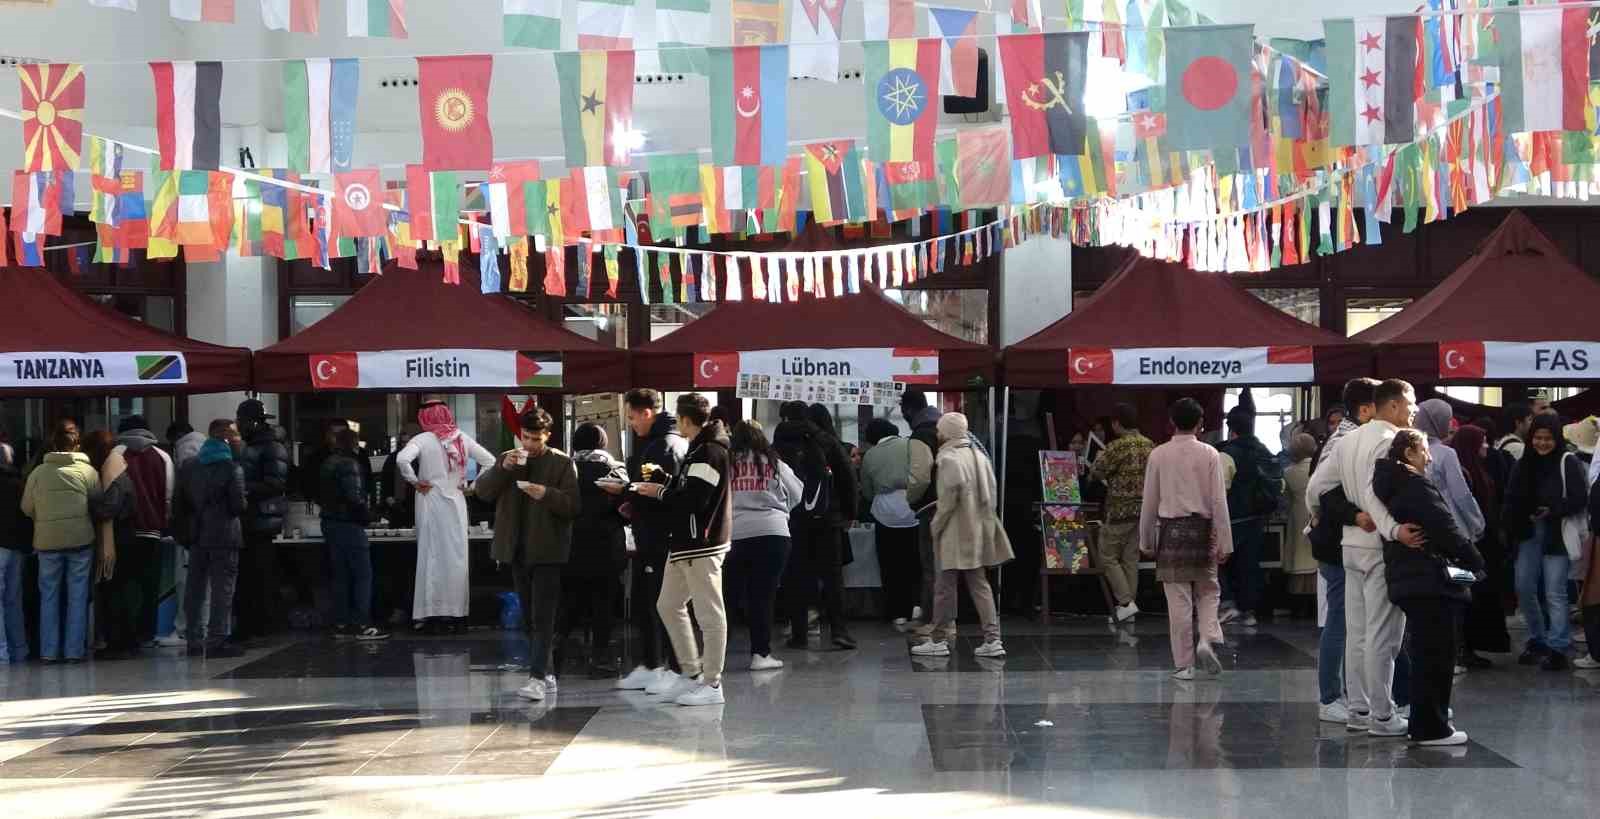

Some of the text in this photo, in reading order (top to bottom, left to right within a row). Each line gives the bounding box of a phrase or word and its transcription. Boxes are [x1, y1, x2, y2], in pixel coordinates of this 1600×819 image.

[13, 358, 105, 380] TANZANYA
[406, 356, 470, 378] Filistin
[782, 357, 851, 377] Lübnan
[1139, 357, 1243, 377] Endonezya
[1535, 349, 1589, 371] FAS
